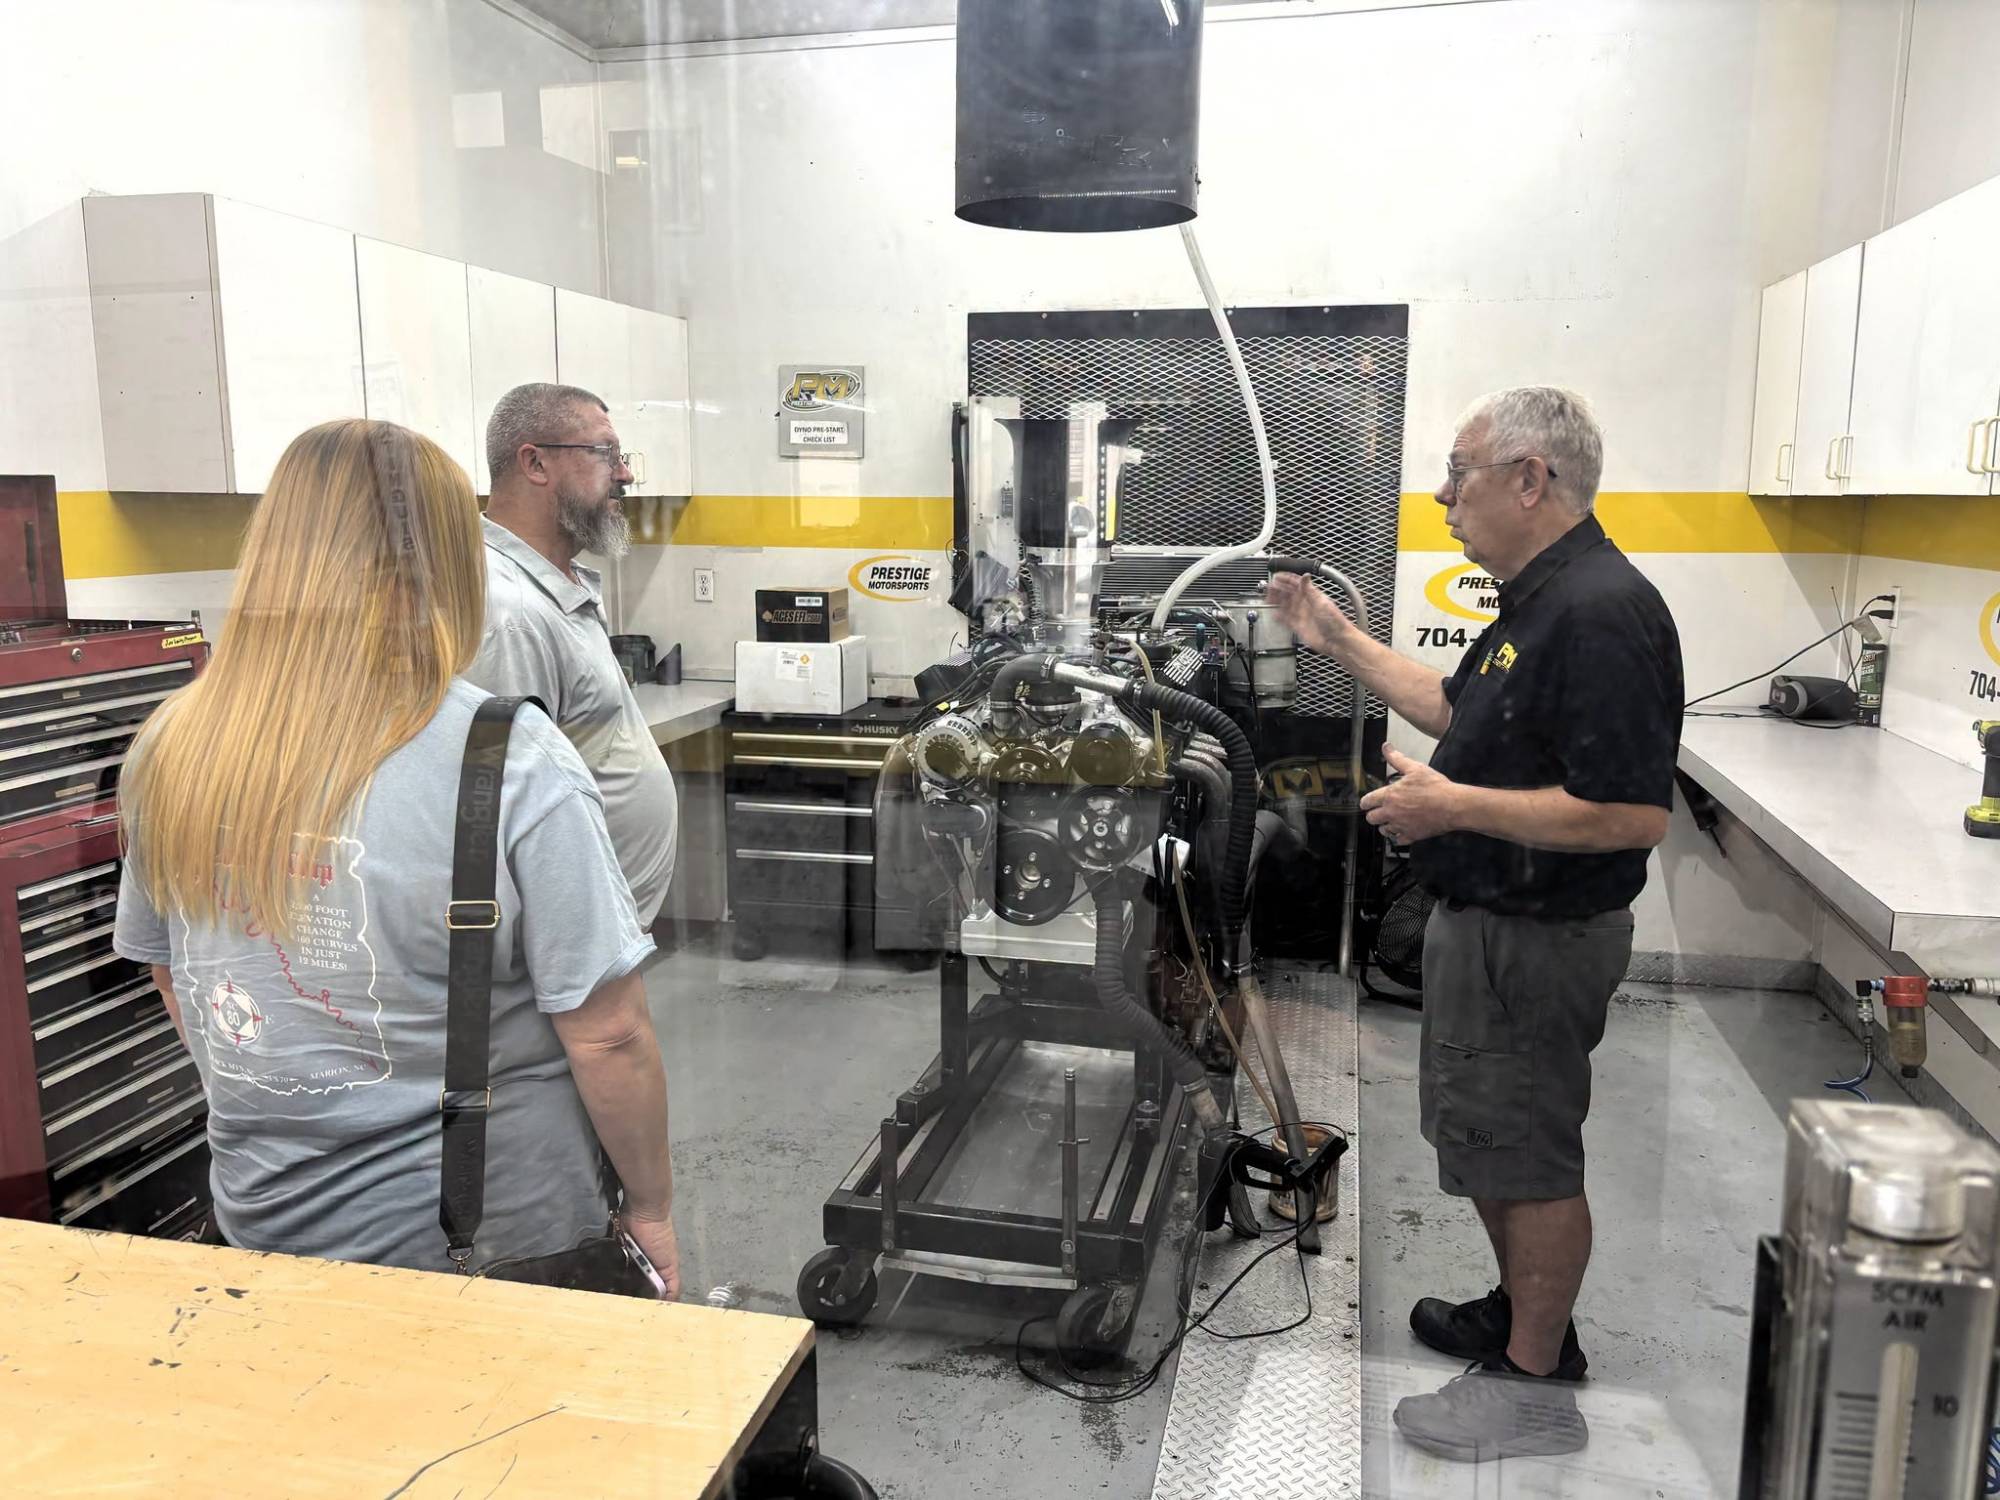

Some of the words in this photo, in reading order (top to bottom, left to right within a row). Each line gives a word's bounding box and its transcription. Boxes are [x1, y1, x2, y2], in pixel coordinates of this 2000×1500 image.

[794, 426, 812, 434] DYNO
[812, 426, 845, 434] PRE-START
[871, 566, 931, 580] PRESTIGE
[868, 580, 930, 590] MOTORSPORTS
[1457, 576, 1503, 589] PRES
[1476, 596, 1500, 608] MO
[1416, 627, 1486, 647] 704-
[1968, 669, 2000, 702] 704-
[863, 724, 899, 735] HUSKY
[461, 743, 506, 862] Wrangler
[312, 894, 320, 902] A
[315, 904, 349, 918] FOOT
[313, 938, 358, 952] CURVES
[301, 946, 313, 955] IN
[314, 948, 342, 959] JUST
[298, 955, 309, 965] 12
[1872, 1281, 1944, 1308] SCFM
[1883, 1311, 1928, 1332] AIR
[1932, 1393, 1960, 1418] 10
